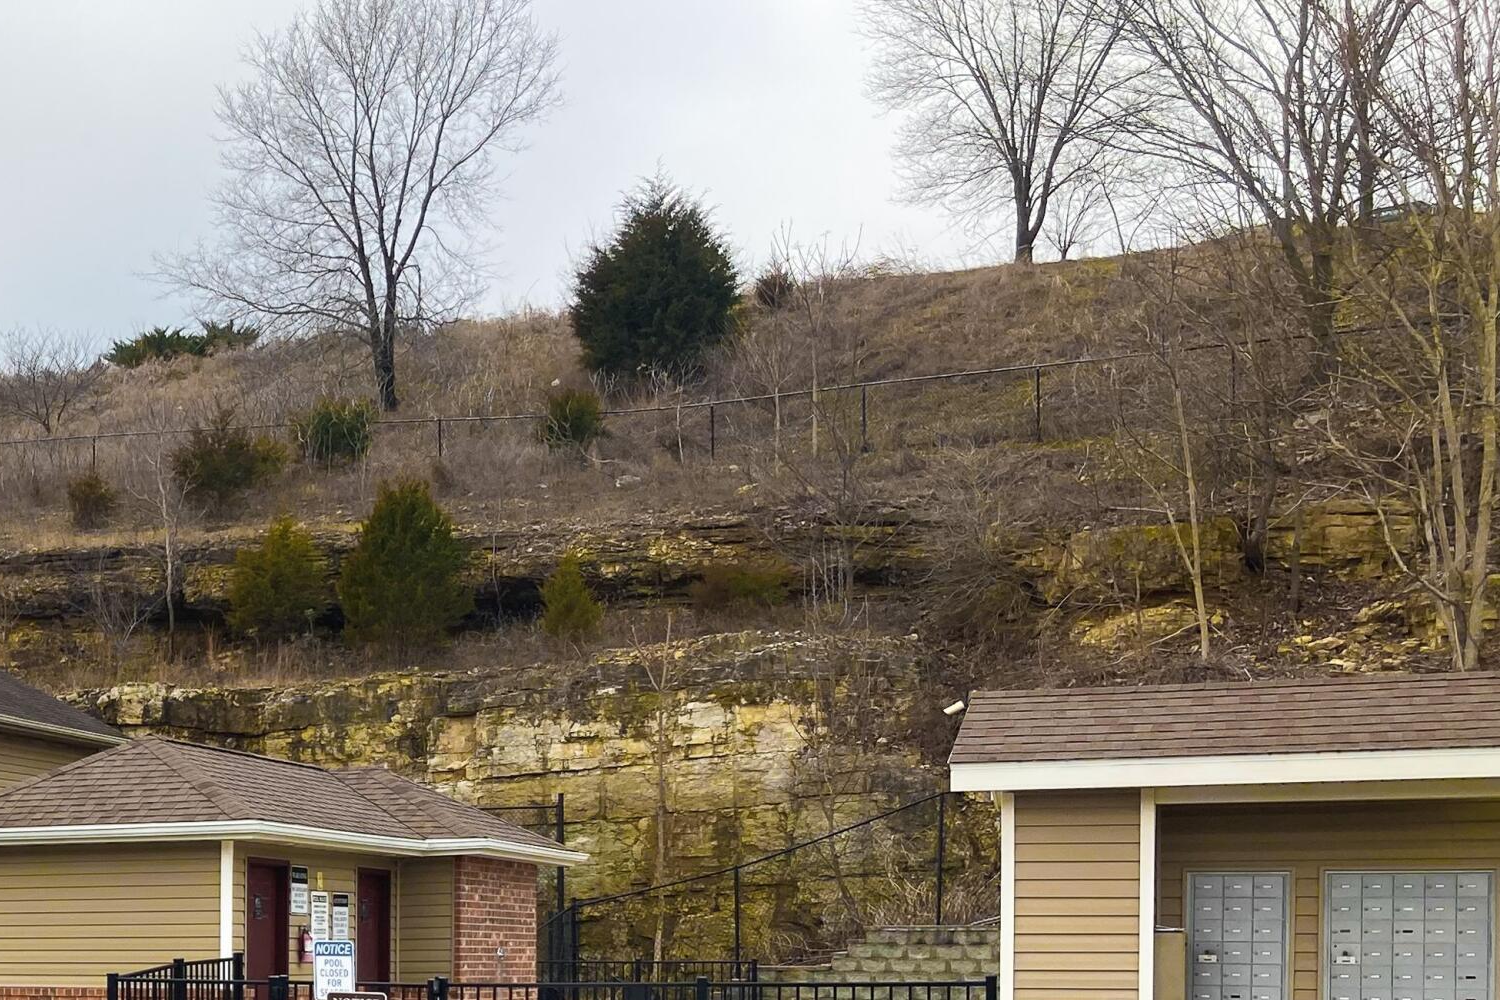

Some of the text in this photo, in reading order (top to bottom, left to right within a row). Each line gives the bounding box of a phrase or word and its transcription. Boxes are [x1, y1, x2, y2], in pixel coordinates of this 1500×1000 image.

[316, 943, 351, 955] NOTICE
[324, 958, 344, 968] POOL
[320, 968, 349, 978] CLOSED
[327, 978, 342, 988] FOR
